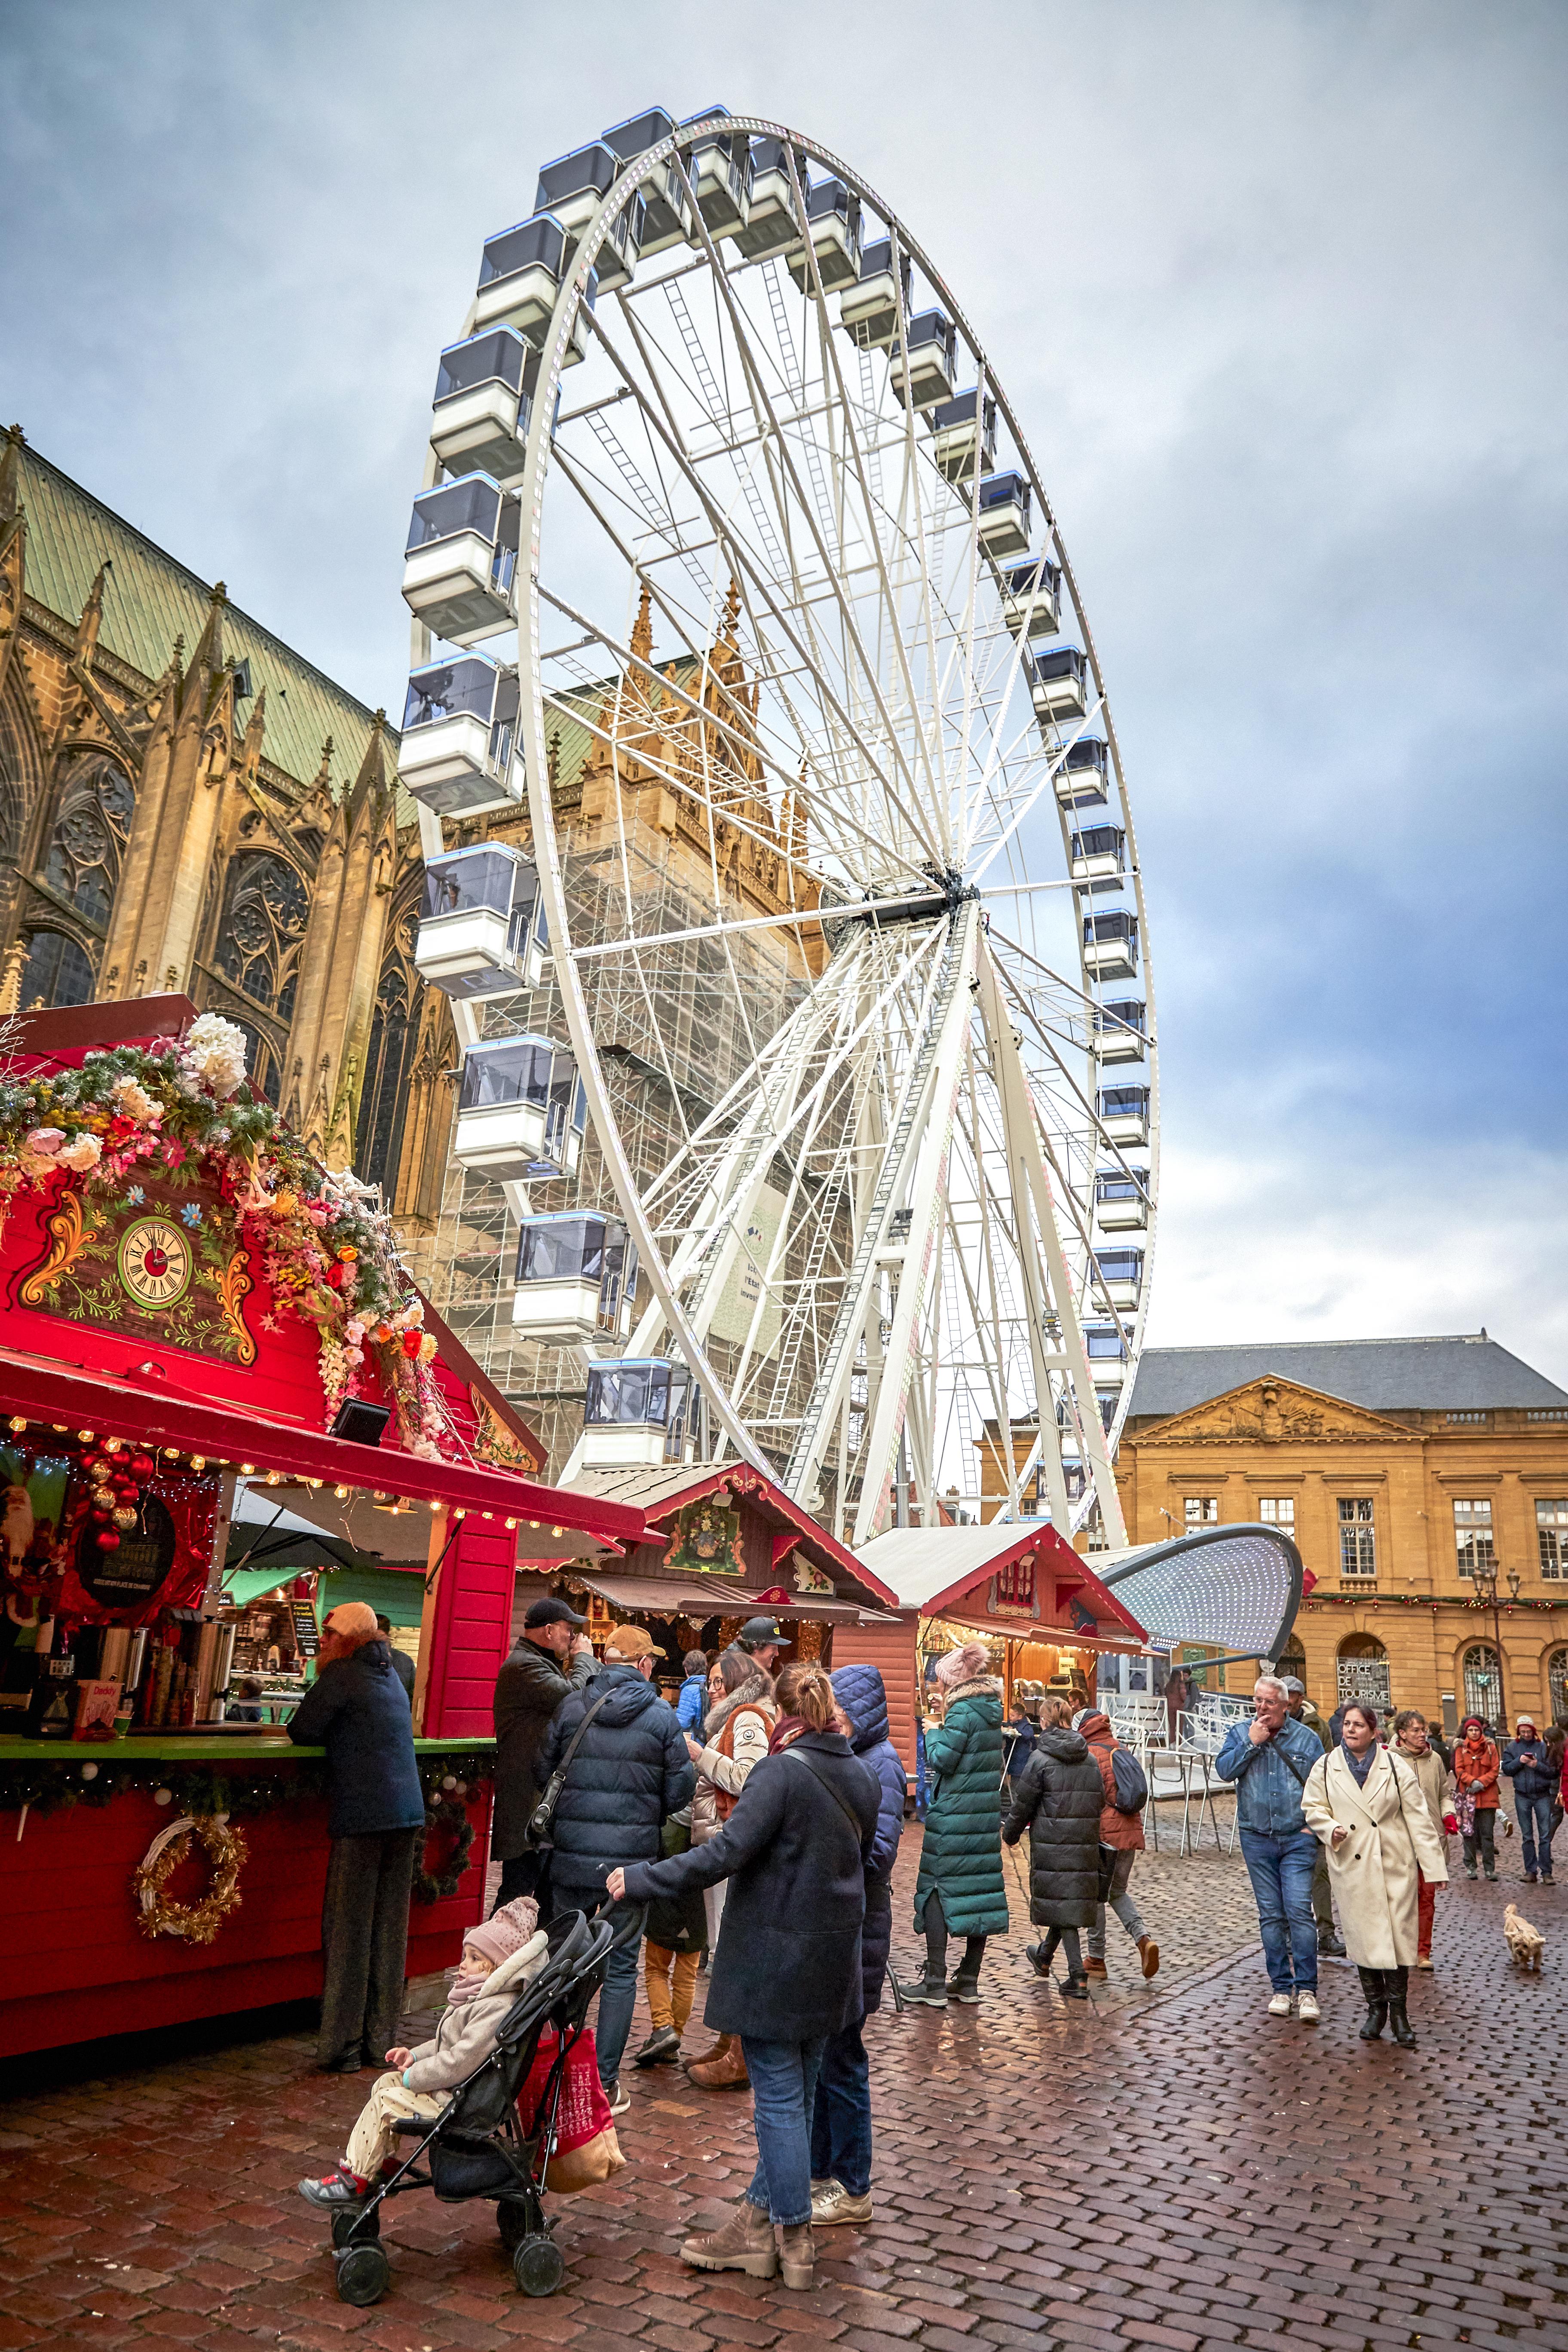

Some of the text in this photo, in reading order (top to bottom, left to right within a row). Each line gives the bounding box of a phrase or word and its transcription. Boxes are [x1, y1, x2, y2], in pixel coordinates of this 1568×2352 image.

[741, 1288, 759, 1303] invest
[1338, 1664, 1371, 1675] OFFICE
[1338, 1676, 1352, 1686] DE
[94, 1686, 116, 1697] Daddy
[1338, 1688, 1390, 1700] TOURISME
